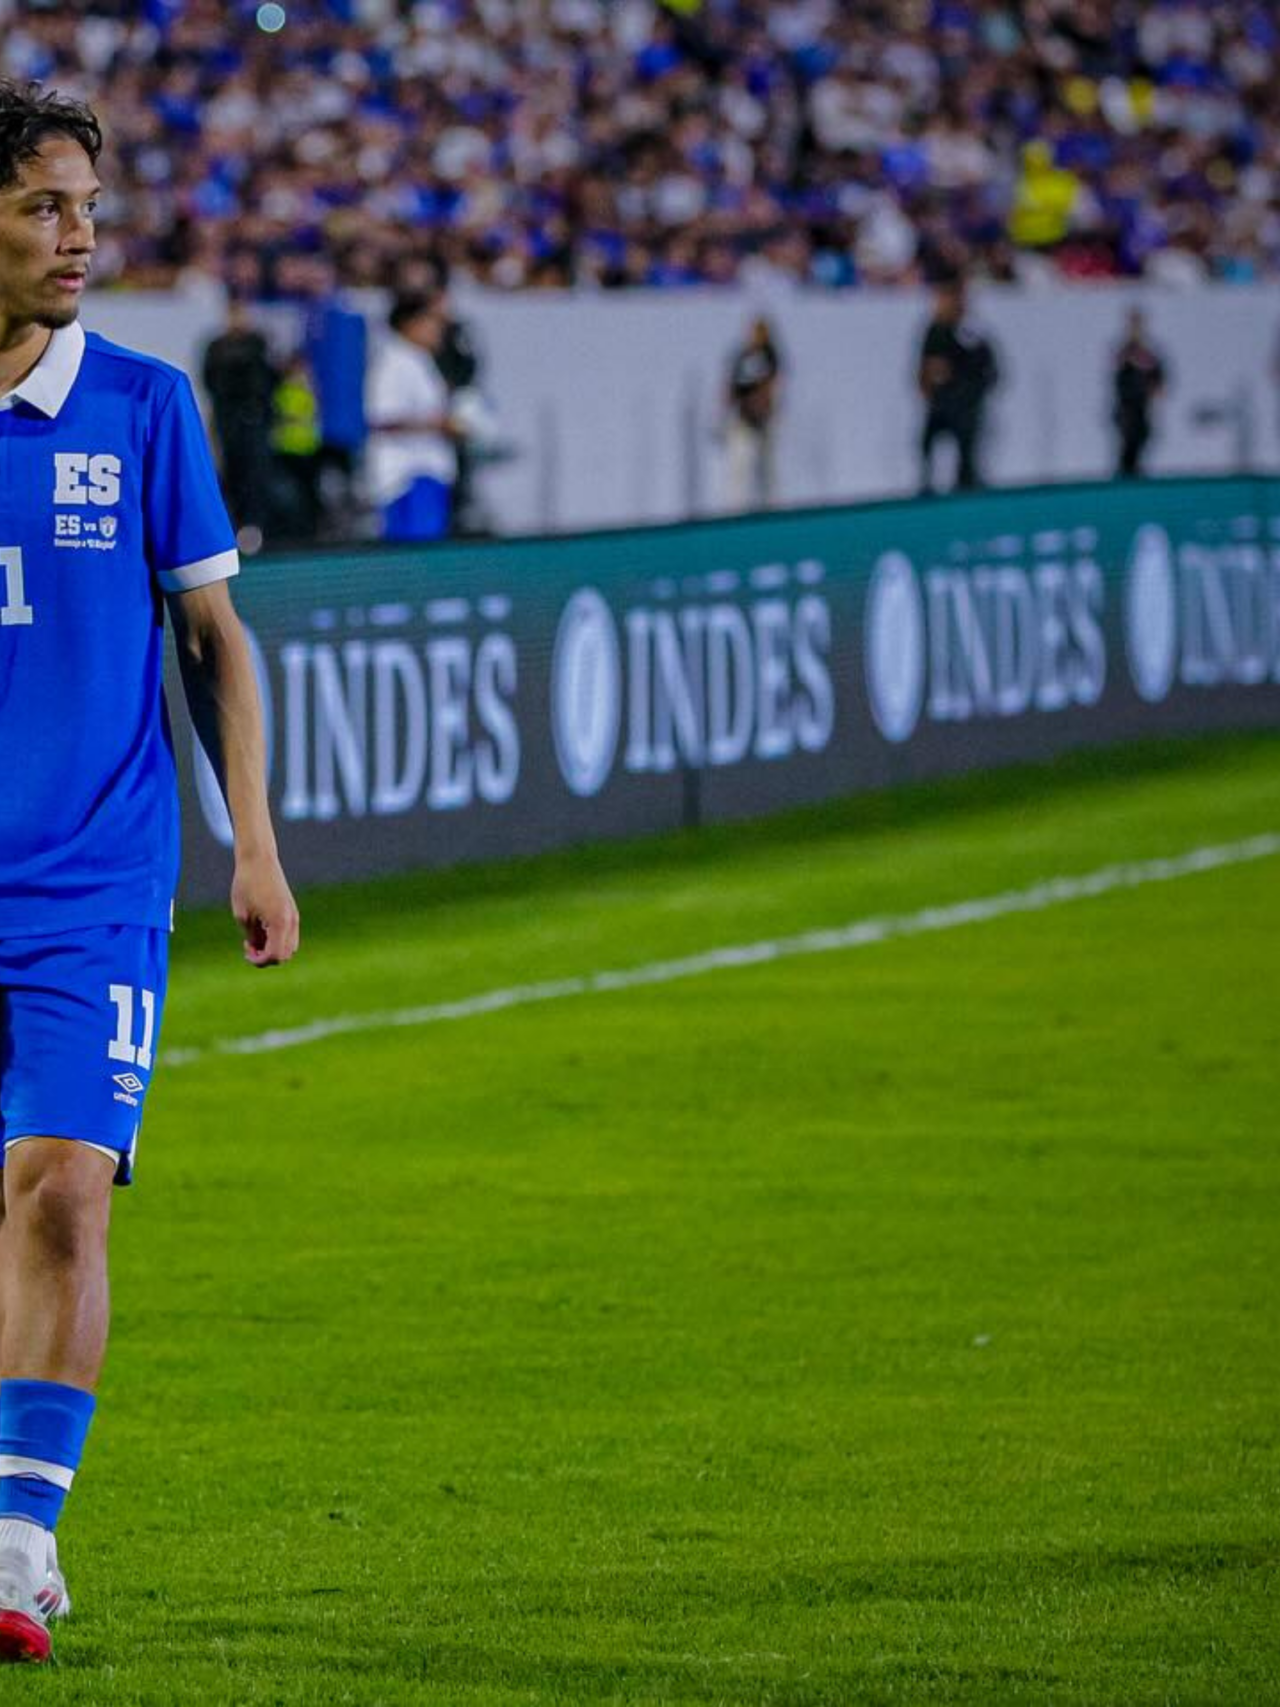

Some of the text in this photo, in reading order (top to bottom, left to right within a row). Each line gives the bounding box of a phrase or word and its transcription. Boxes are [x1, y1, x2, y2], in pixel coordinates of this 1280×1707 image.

[53, 452, 121, 506] ES
[55, 513, 81, 535] ES
[280, 632, 520, 821] INDES
[625, 594, 835, 772] INDES
[108, 983, 154, 1071] 11
